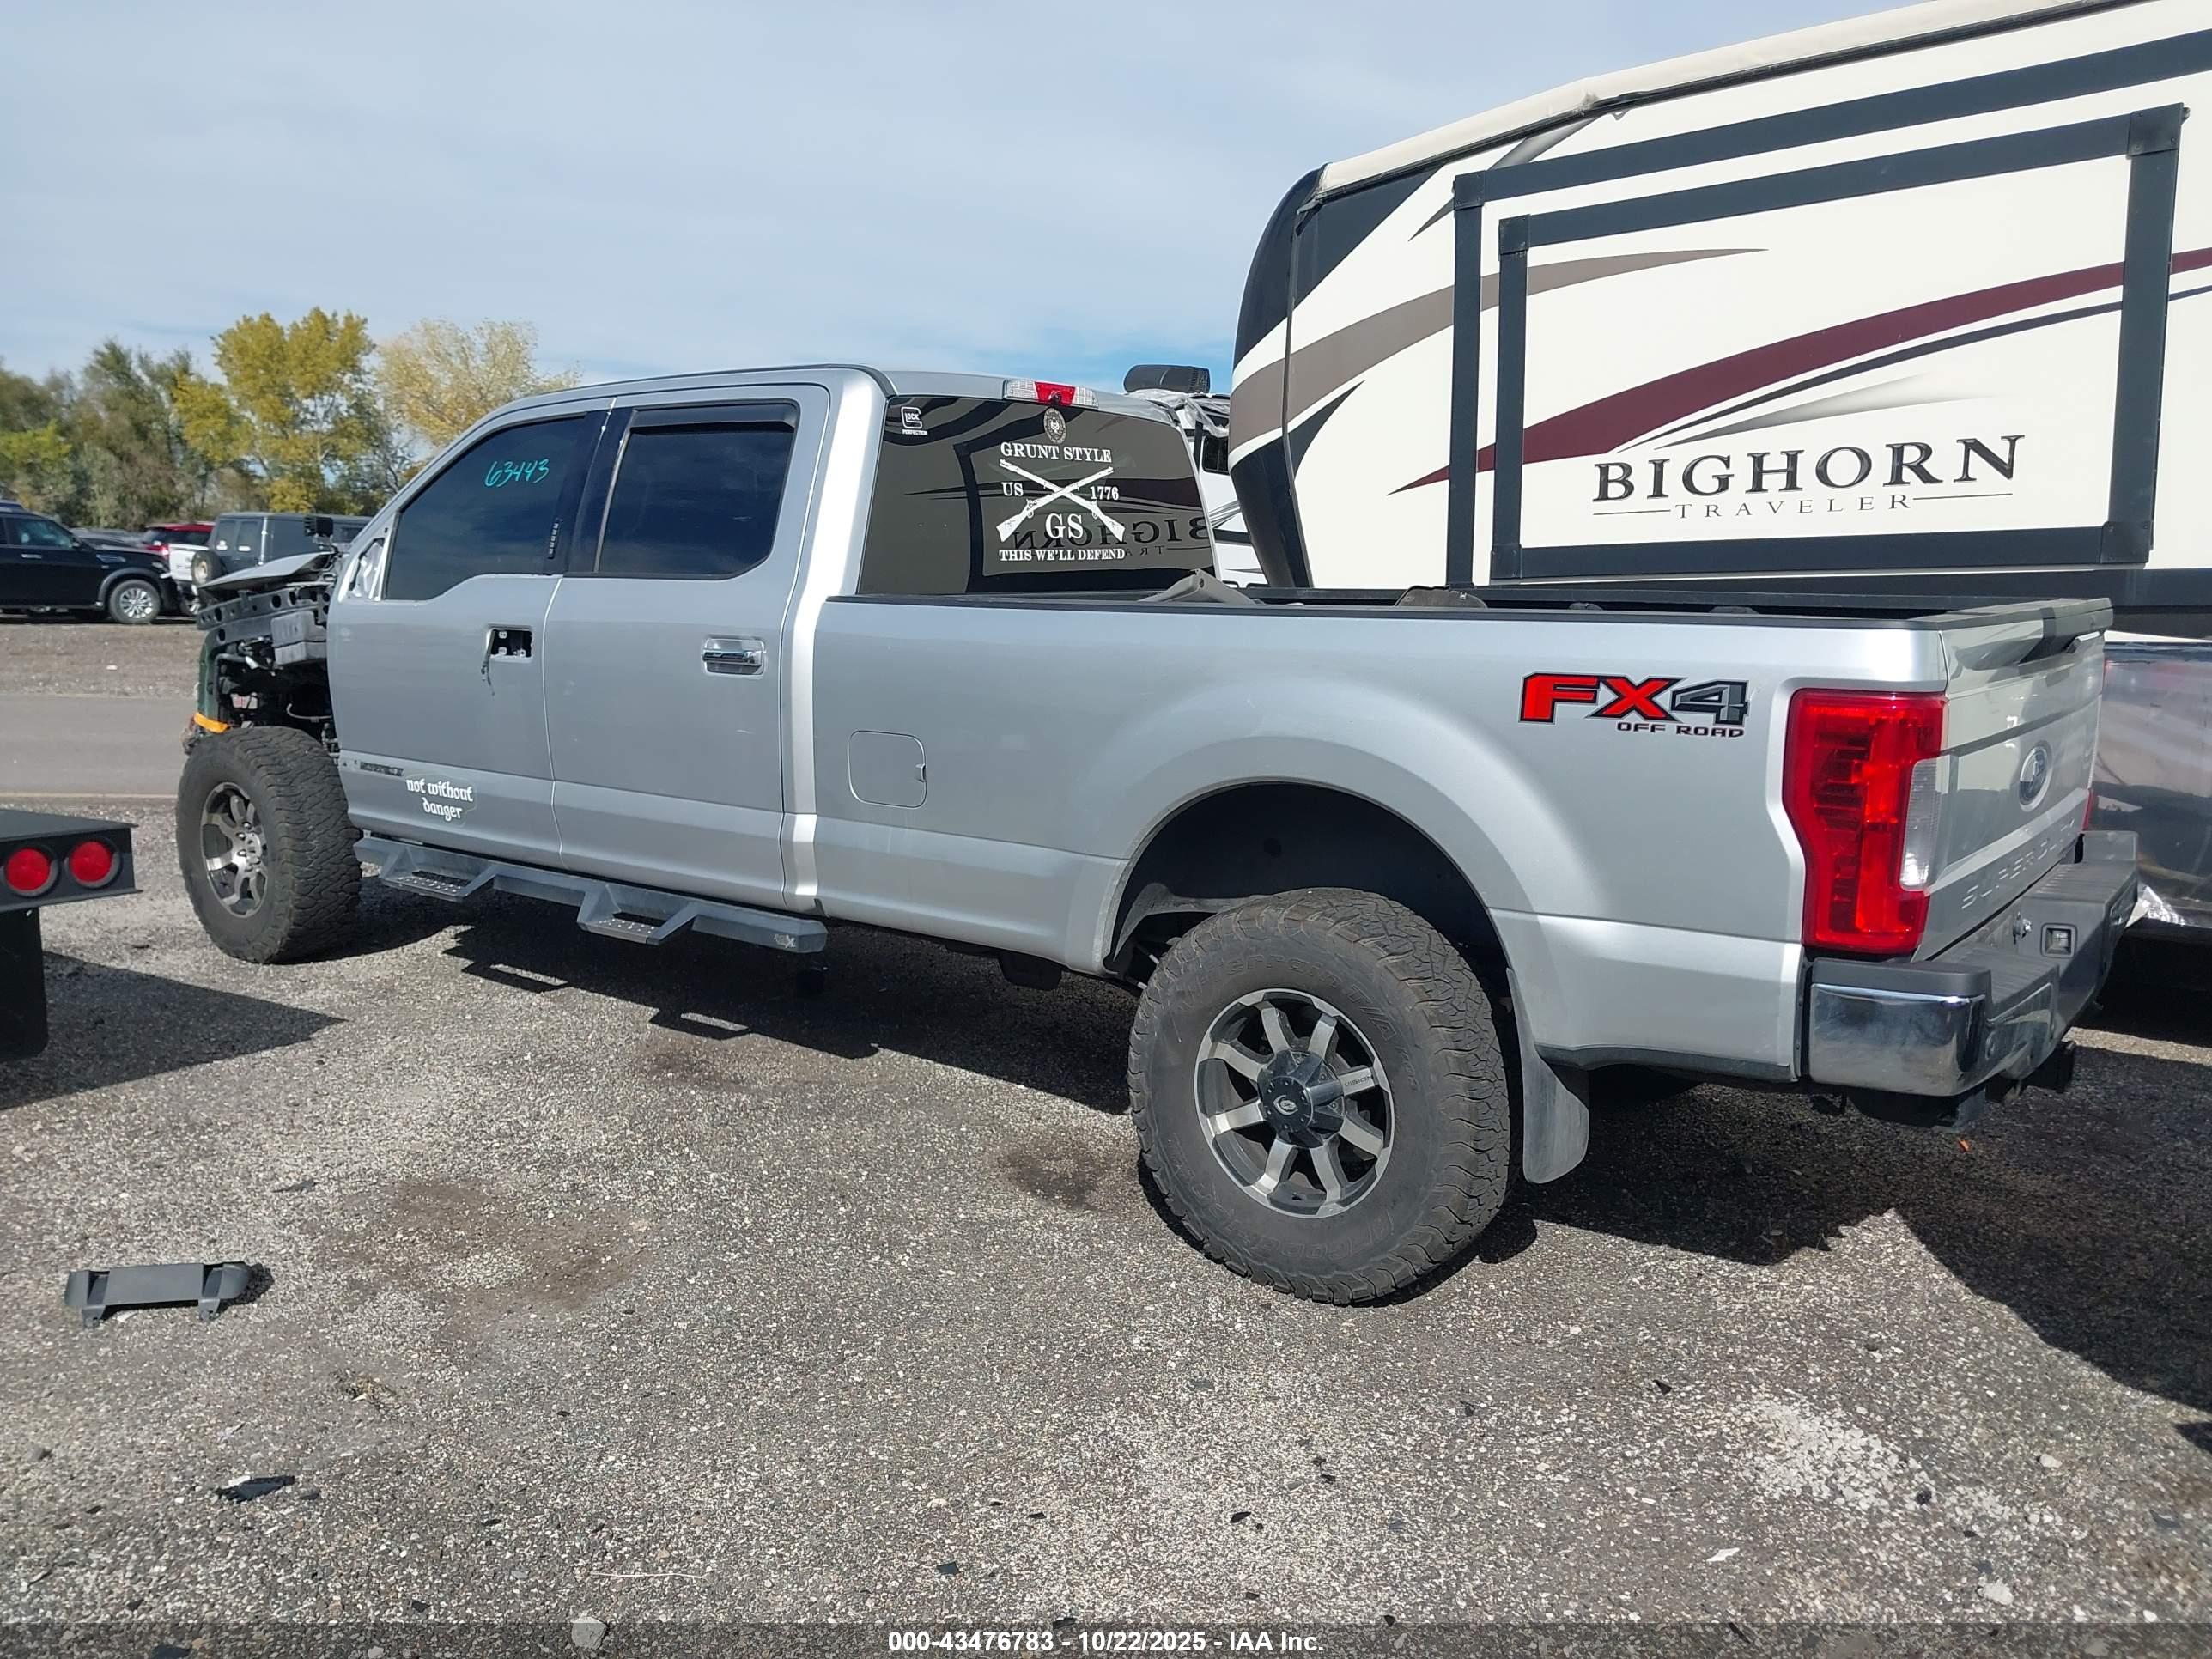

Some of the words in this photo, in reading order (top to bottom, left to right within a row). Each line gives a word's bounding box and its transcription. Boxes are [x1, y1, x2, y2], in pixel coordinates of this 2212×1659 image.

[1000, 442, 1060, 460] GRUNT
[1064, 445, 1113, 464] STYLE
[484, 459, 550, 488] 63443
[1593, 434, 2026, 502] BIGHORN
[1001, 482, 1024, 497] US
[1090, 486, 1120, 501] 1776
[1675, 493, 1911, 520] TRAVELER
[1045, 514, 1084, 539] GS
[999, 549, 1032, 562] THIS
[1035, 549, 1075, 562] WE'LL
[1077, 549, 1126, 561] DEFEND
[1518, 672, 1751, 727] FX4
[1616, 721, 1667, 733] OFF
[1675, 725, 1746, 738] ROAD
[406, 778, 426, 793] not
[427, 780, 474, 802] without
[421, 797, 463, 821] danger
